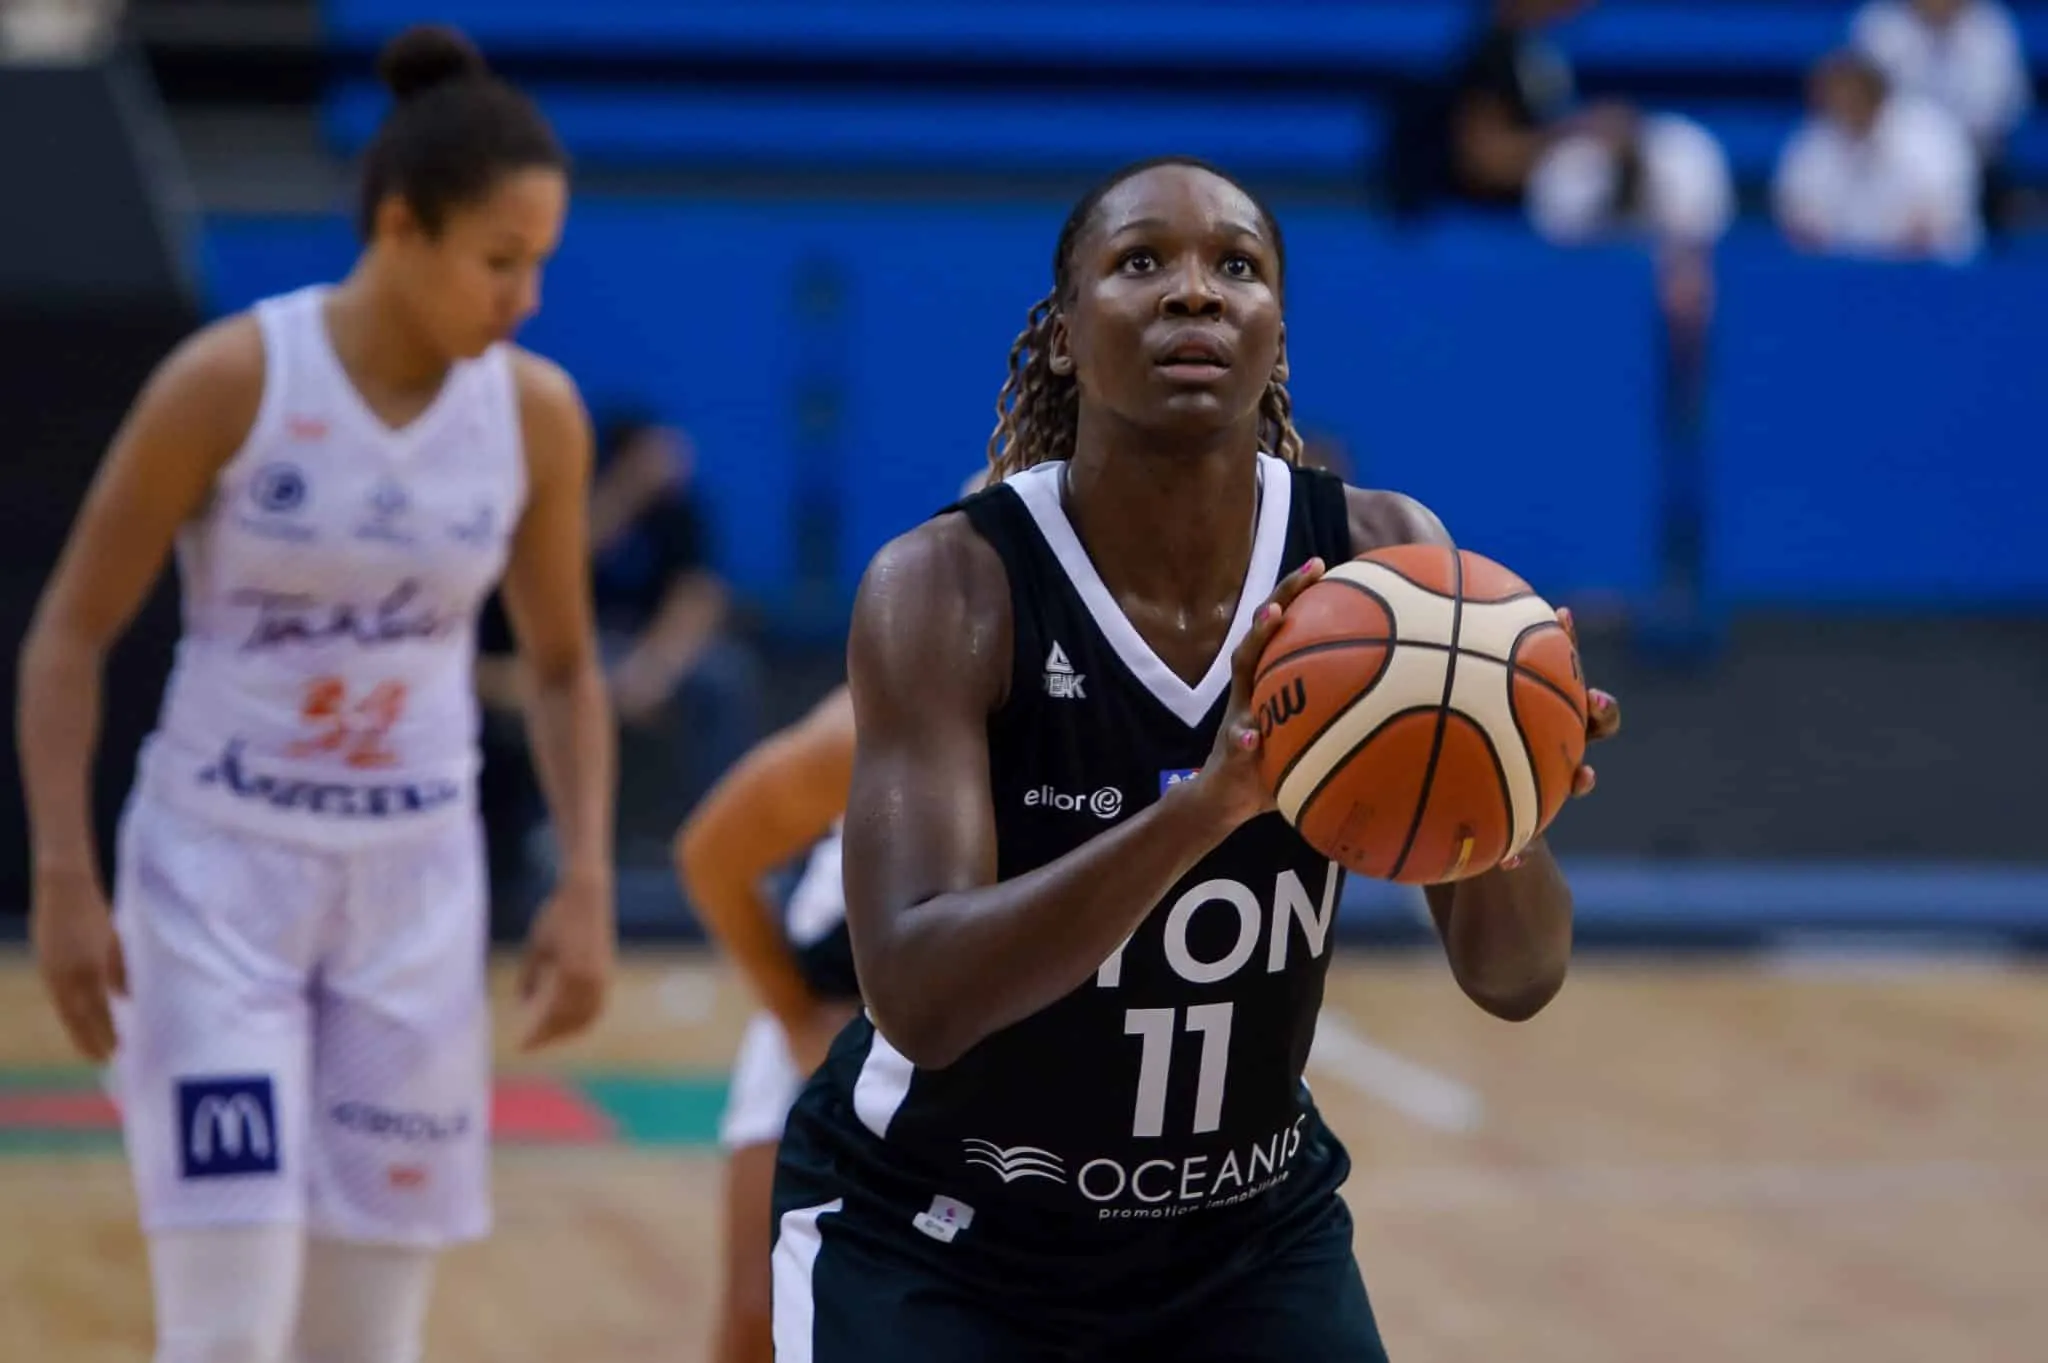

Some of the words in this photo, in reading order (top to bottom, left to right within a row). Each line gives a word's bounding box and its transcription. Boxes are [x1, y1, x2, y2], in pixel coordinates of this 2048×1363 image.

[1024, 785, 1086, 811] elior
[1124, 1001, 1234, 1137] 11
[1078, 1113, 1306, 1202] OCEANIS
[1098, 1203, 1200, 1220] promotion
